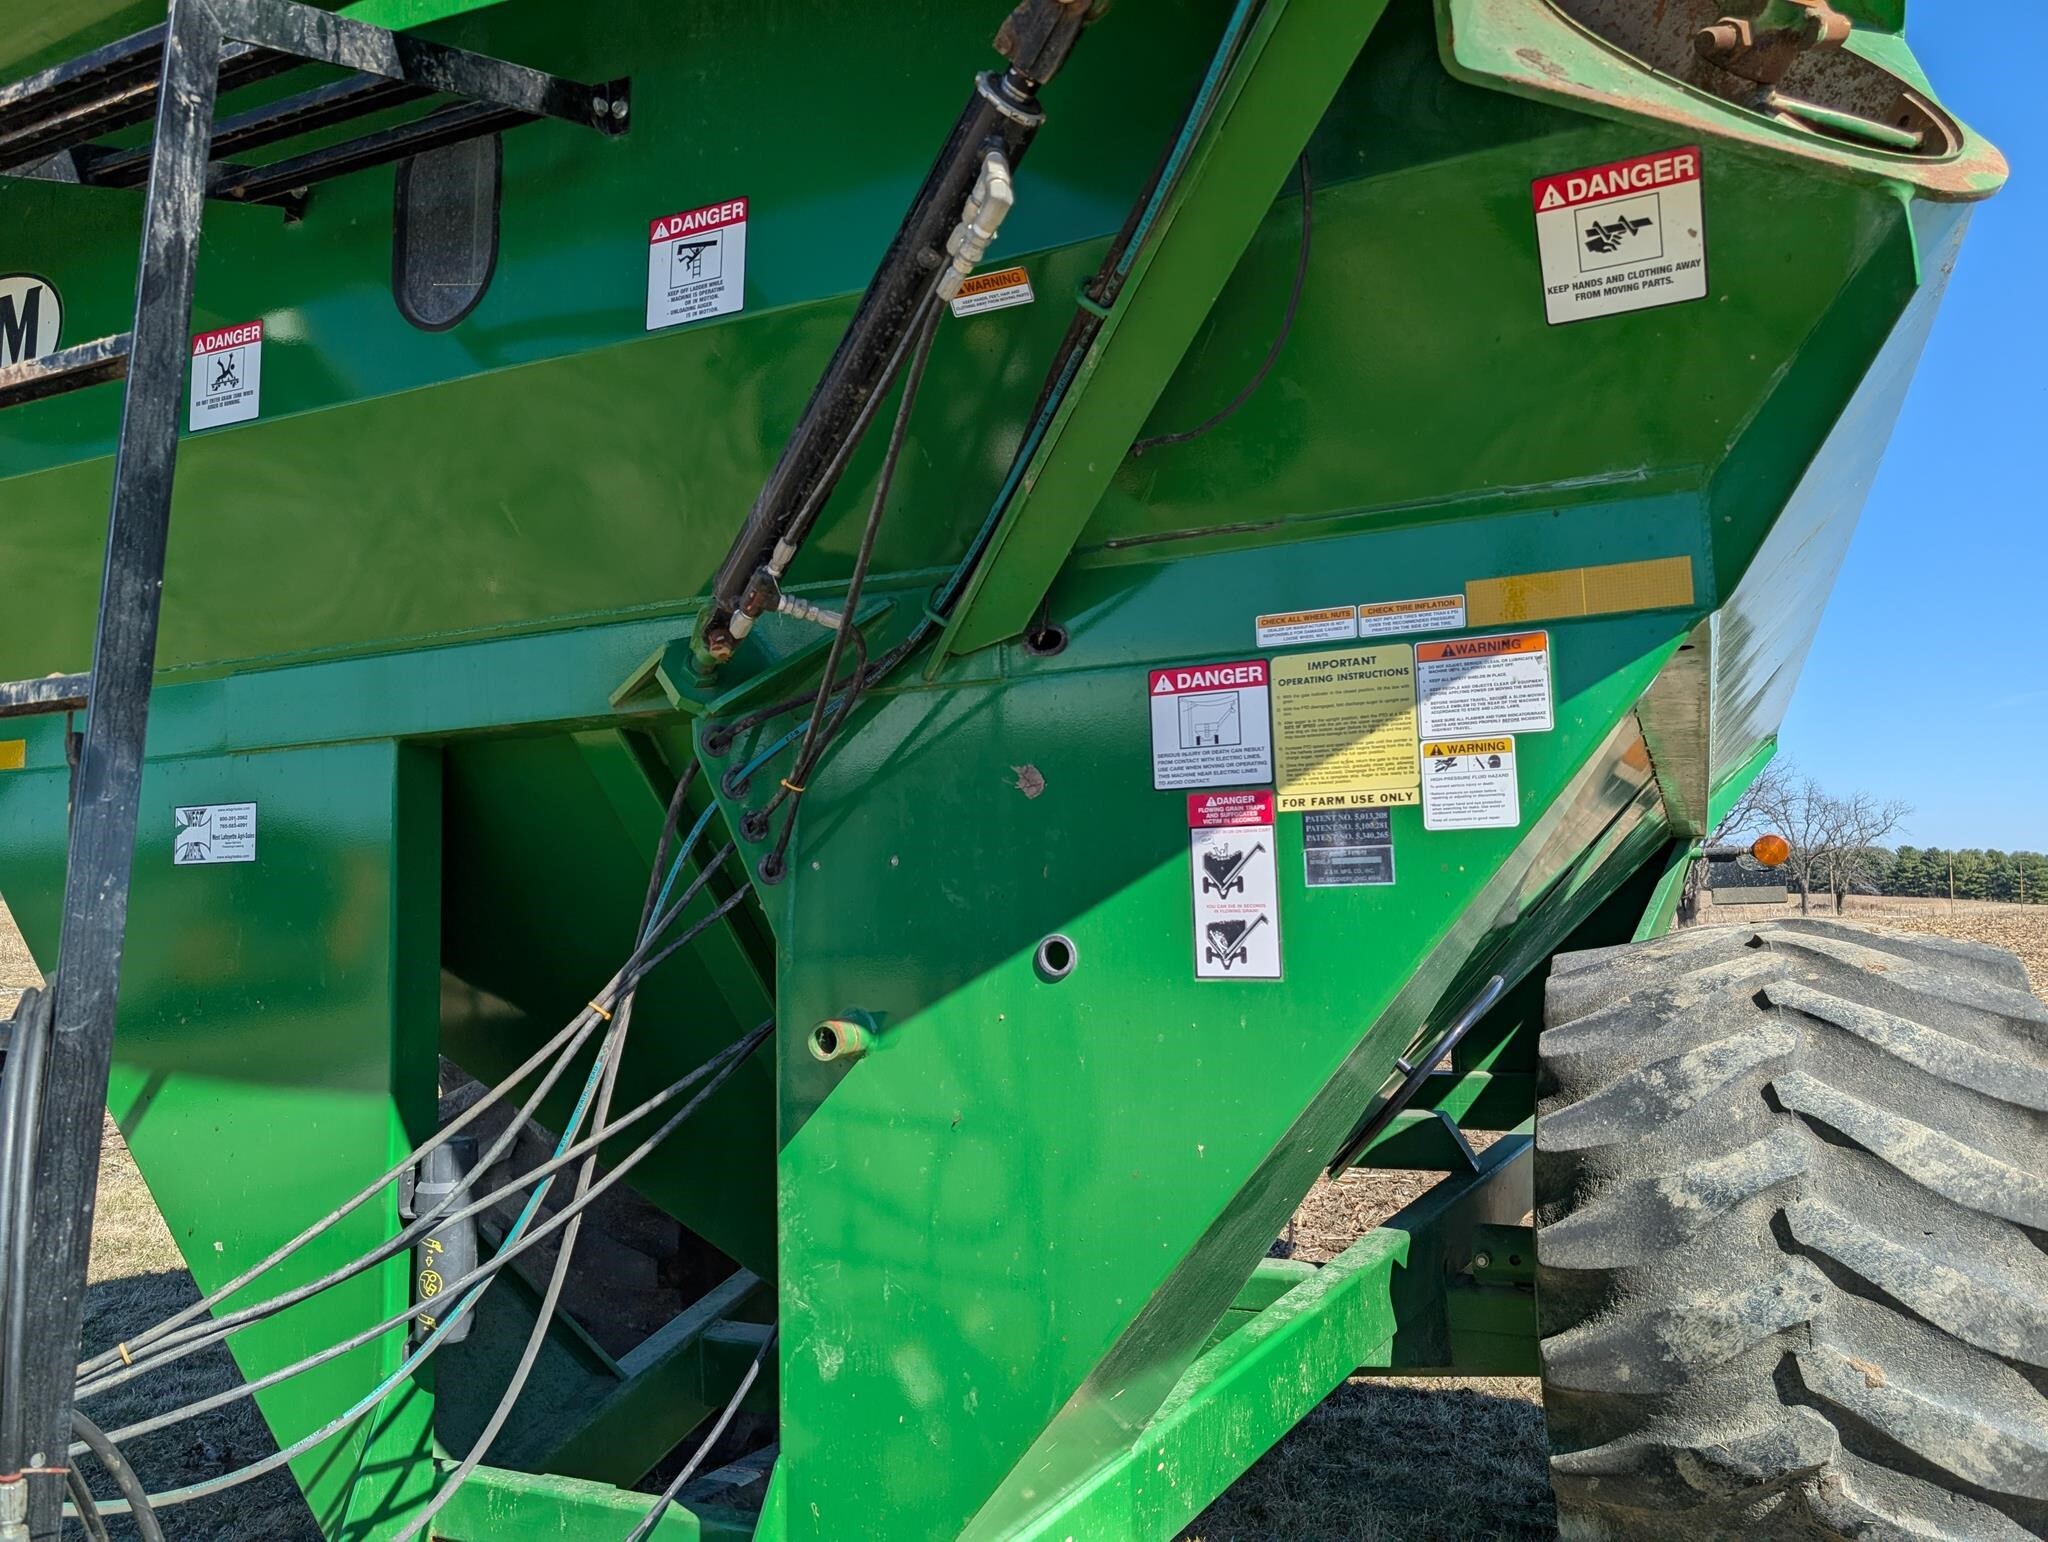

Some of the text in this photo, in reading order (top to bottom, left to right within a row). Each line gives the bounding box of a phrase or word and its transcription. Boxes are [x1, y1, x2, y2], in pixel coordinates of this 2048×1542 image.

[1567, 154, 1694, 202] DANGER
[670, 201, 744, 235] DANGER
[963, 272, 1020, 292] WARNING
[1547, 259, 1701, 295] KEEP HANDS AND CLOTHING AWAY
[668, 289, 679, 297] KEEP
[690, 283, 707, 292] LADDER
[709, 280, 722, 288] WHILE
[671, 293, 691, 302] MACHINE
[699, 285, 724, 296] OPERATING
[1575, 276, 1674, 301] FROM MOVING PARTS.
[671, 301, 712, 315] UNLOADING AUGER
[206, 325, 260, 350] DANGER
[1368, 600, 1456, 615] CHECK TIRE INFLATION
[1261, 617, 1286, 626] CHECK
[1303, 613, 1329, 621] WHEEL
[1331, 610, 1351, 619] NUTS
[1456, 639, 1521, 654] WARNING
[1307, 655, 1377, 671] IMPORTANT
[1177, 666, 1263, 689] DANGER
[1278, 667, 1409, 687] OPERATING INSTRUCTIONS
[1447, 741, 1505, 754] WARNING
[1216, 795, 1255, 805] DANGER
[1282, 792, 1414, 807] FOR FARM USE ONLY
[1305, 814, 1337, 823] PATENT
[1305, 824, 1337, 832] PATENT
[1338, 823, 1353, 831] NO.
